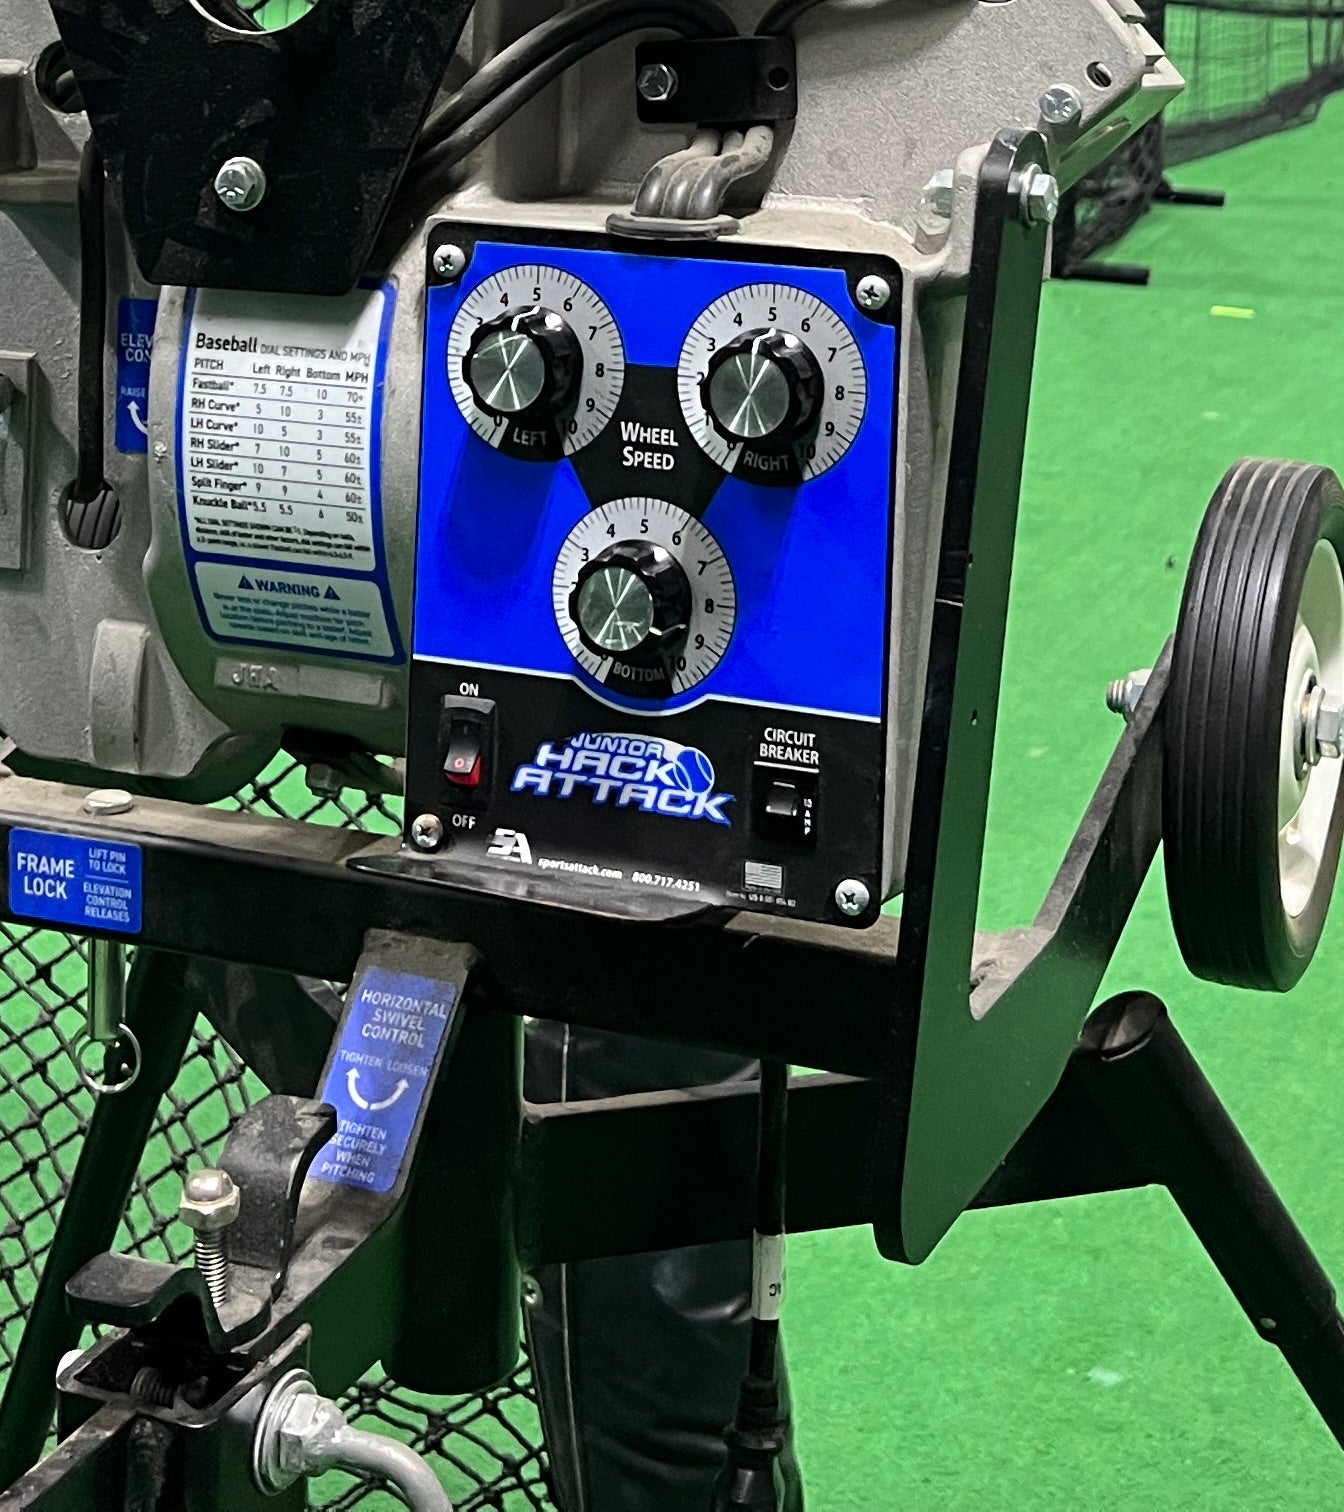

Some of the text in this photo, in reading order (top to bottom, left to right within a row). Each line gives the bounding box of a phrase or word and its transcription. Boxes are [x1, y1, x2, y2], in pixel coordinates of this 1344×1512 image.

[500, 292, 509, 306] 4
[533, 288, 541, 301] 5
[564, 297, 573, 311] 6
[733, 312, 742, 327] 4
[768, 307, 777, 321] 5
[589, 326, 597, 340] 7
[801, 318, 810, 332] 6
[195, 332, 258, 353] Baseball
[260, 344, 280, 356] DIAL
[283, 346, 327, 359] SETTINGS
[328, 349, 347, 361] AND
[707, 338, 716, 352] 3
[828, 347, 837, 362] 7
[194, 358, 368, 383] PITCH Left Right Bottom MPH
[596, 363, 604, 377] 8
[254, 383, 267, 395] 7.5
[280, 385, 294, 397] 7.5
[317, 389, 328, 400] 10
[835, 385, 844, 400] 8
[191, 398, 206, 410] RH
[256, 403, 261, 415] 5
[280, 406, 291, 417] 10
[318, 409, 324, 421] 3
[586, 398, 595, 412] 9
[190, 417, 204, 429] LH
[254, 423, 264, 435] 10
[281, 426, 287, 437] 5
[317, 430, 323, 440] 3
[561, 418, 577, 434] 10
[620, 421, 679, 447] WHEEL
[825, 422, 835, 436] 9
[513, 427, 547, 445] LEFT
[191, 436, 204, 448] RH
[255, 443, 261, 455] 7
[279, 445, 290, 458] 10
[316, 449, 322, 461] 5
[800, 443, 816, 459] 10
[623, 446, 674, 470] SPEED
[744, 451, 789, 471] RIGHT
[190, 456, 204, 468] LH
[253, 463, 264, 475] 10
[281, 466, 287, 476] 7
[317, 469, 323, 481] 5
[191, 476, 212, 489] Split
[256, 483, 261, 494] 9
[282, 485, 288, 496] 9
[317, 489, 323, 500] 4
[192, 496, 228, 509] Knuckle
[254, 501, 267, 513] 5.5
[279, 503, 294, 516] 5.5
[607, 524, 615, 538] 4
[640, 519, 649, 533] 5
[672, 531, 682, 546] 6
[581, 548, 589, 562] 3
[697, 561, 706, 576] 7
[255, 579, 320, 598] WARNING
[705, 598, 714, 613] 8
[695, 634, 704, 649] 9
[614, 662, 664, 682] BOTTOM
[670, 655, 686, 672] 10
[459, 682, 479, 696] ON
[764, 727, 816, 747] CIRCUIT
[570, 733, 664, 760] JUNIOR
[759, 743, 819, 765] BREAKER
[536, 743, 676, 787] HACK
[511, 765, 736, 827] ATTACK
[452, 814, 476, 829] OFF
[88, 848, 126, 862] LIFT PIN
[17, 852, 75, 878] FRAME
[89, 859, 126, 875] TO LOCK
[538, 858, 700, 892] sportsattack.com 800.717.4251
[24, 876, 68, 900] LOCK
[83, 882, 132, 899] ELEVATION
[86, 894, 128, 910] CONTROL
[84, 906, 130, 922] RELEASES
[360, 989, 447, 1019] HORIZONTAL
[372, 1008, 426, 1031] SWIVEL
[361, 1023, 425, 1048] CONTROL
[340, 1049, 429, 1079] TIGHTEN LOOSEN
[336, 1149, 371, 1167] WHEN
[321, 1162, 375, 1184] PITCHING
